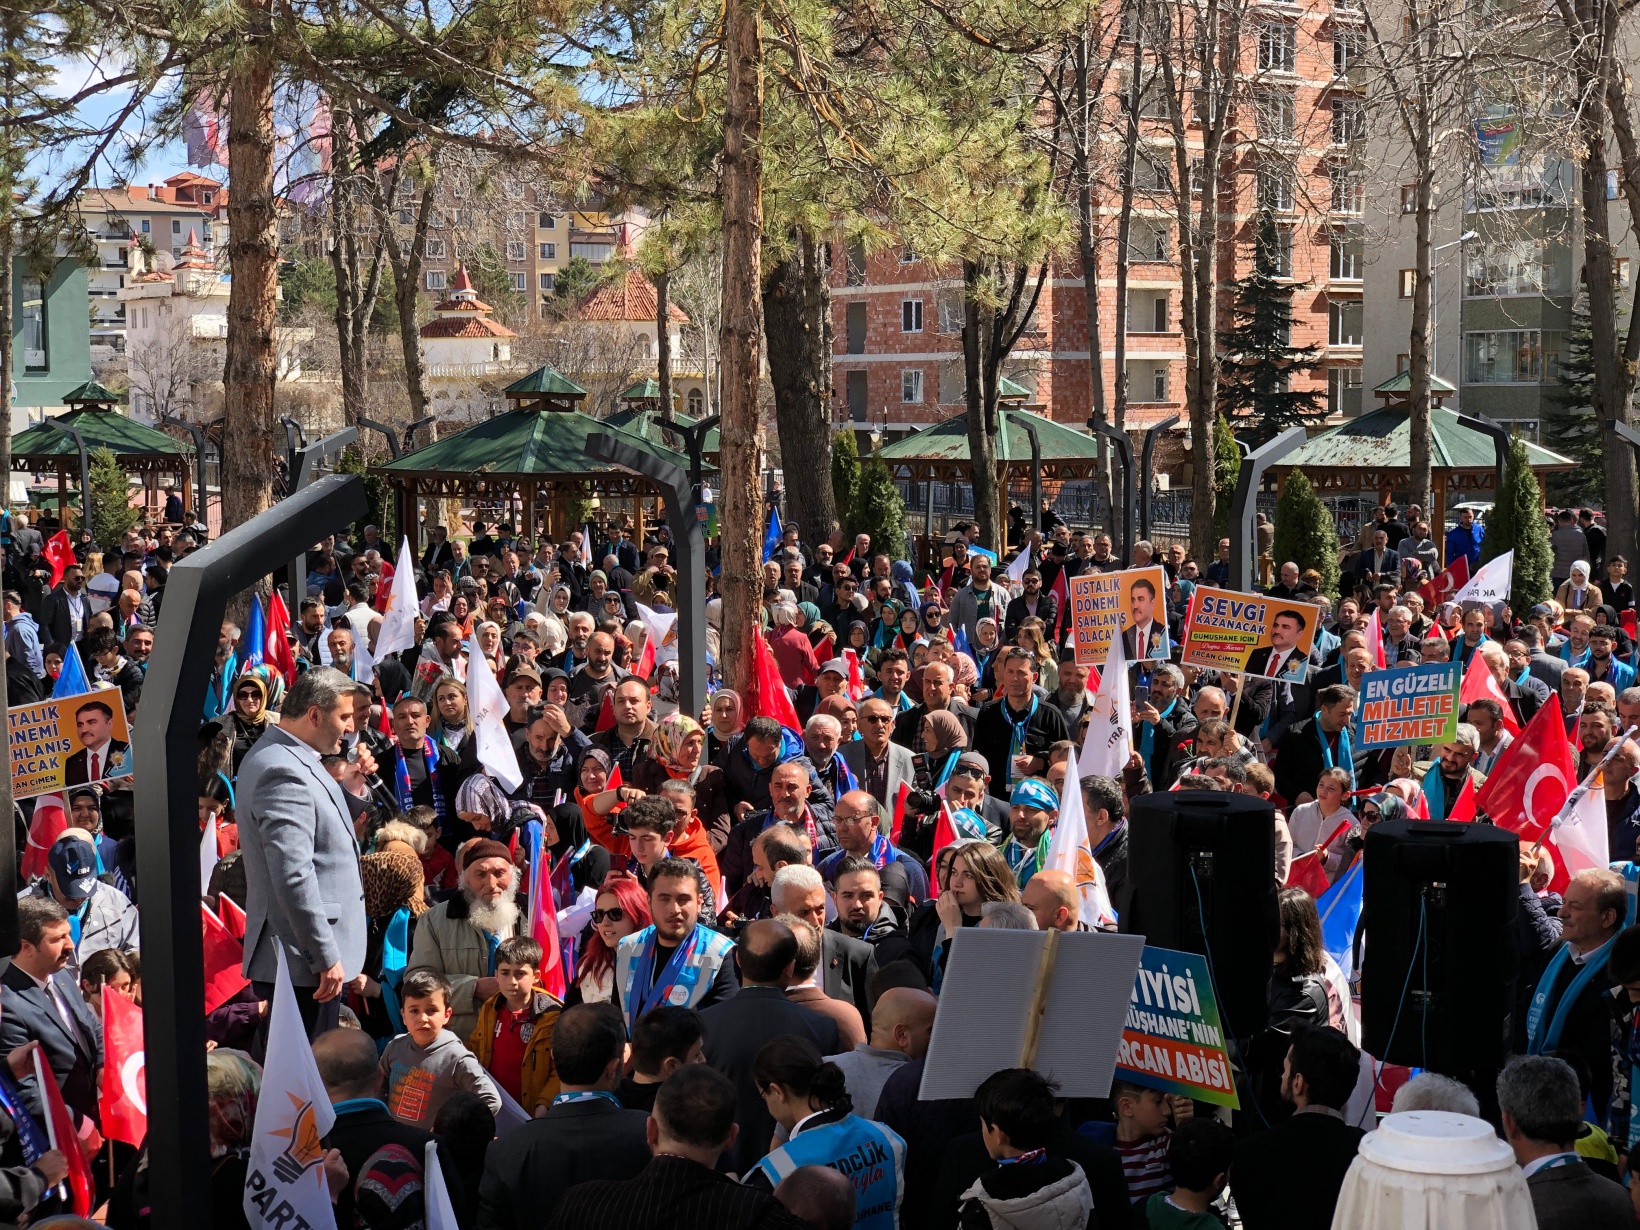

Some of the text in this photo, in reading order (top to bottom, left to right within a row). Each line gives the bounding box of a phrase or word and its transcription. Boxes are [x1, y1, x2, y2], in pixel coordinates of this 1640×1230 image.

[1075, 578, 1120, 595] USTALIK
[1077, 593, 1119, 612] DÖNEMİ
[1078, 612, 1127, 630] ŞAHLANŞ
[1195, 614, 1267, 635] KAZANACAK
[1079, 629, 1114, 643] OLACA
[1191, 650, 1216, 660] ERCAN
[1366, 668, 1454, 698] EN GÜZELİ
[8, 705, 60, 728] TALIK
[1362, 694, 1454, 722] MİLLETE
[1363, 717, 1448, 744] HİZMET
[10, 738, 71, 761] HLANIŞ
[11, 756, 60, 777] ACAK
[1176, 1050, 1230, 1090] ABİSİ
[246, 1169, 314, 1230] PART
